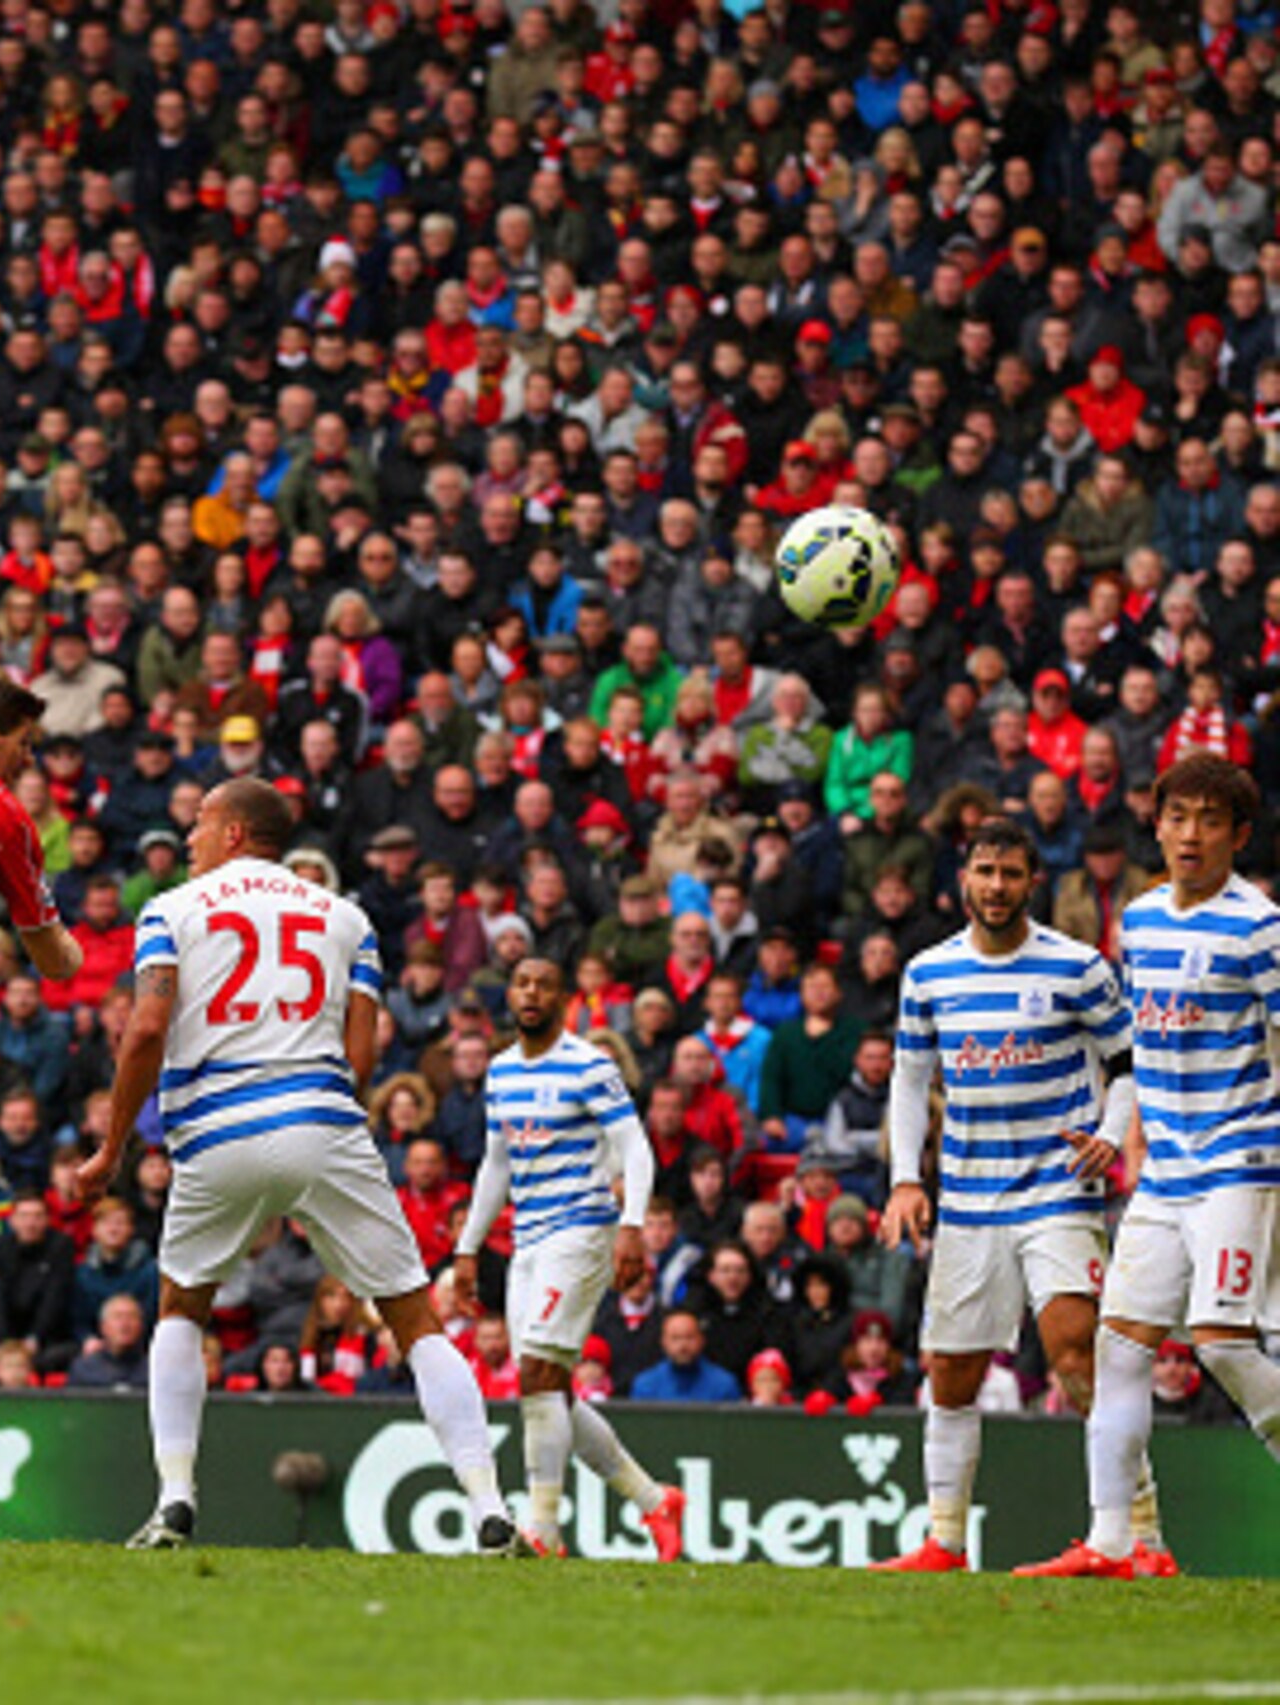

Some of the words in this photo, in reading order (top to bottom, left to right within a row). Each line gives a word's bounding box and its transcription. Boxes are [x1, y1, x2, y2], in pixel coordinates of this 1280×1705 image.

[206, 911, 327, 1026] 25
[1216, 1248, 1253, 1296] 13
[539, 1285, 564, 1321] 7
